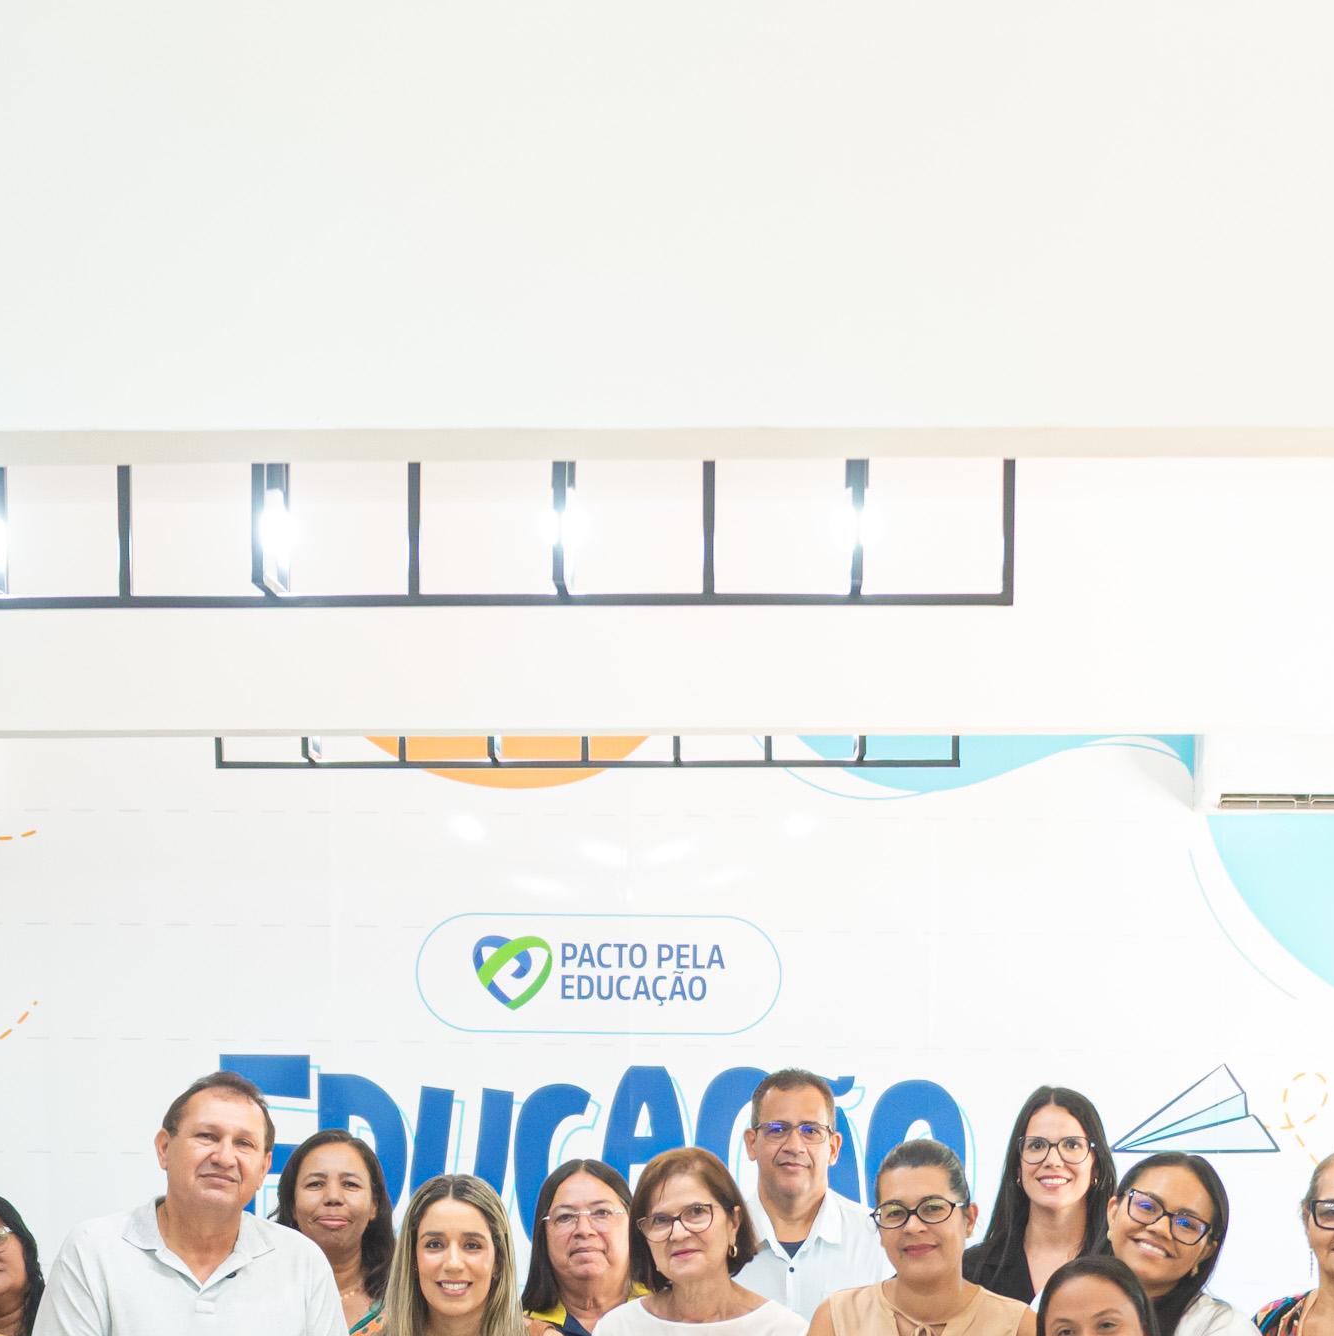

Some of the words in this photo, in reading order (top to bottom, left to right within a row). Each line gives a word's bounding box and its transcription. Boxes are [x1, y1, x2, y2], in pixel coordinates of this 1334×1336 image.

[561, 943, 647, 968] PACTO
[657, 944, 725, 969] PELA
[561, 971, 707, 1006] EDUCAÇÃO
